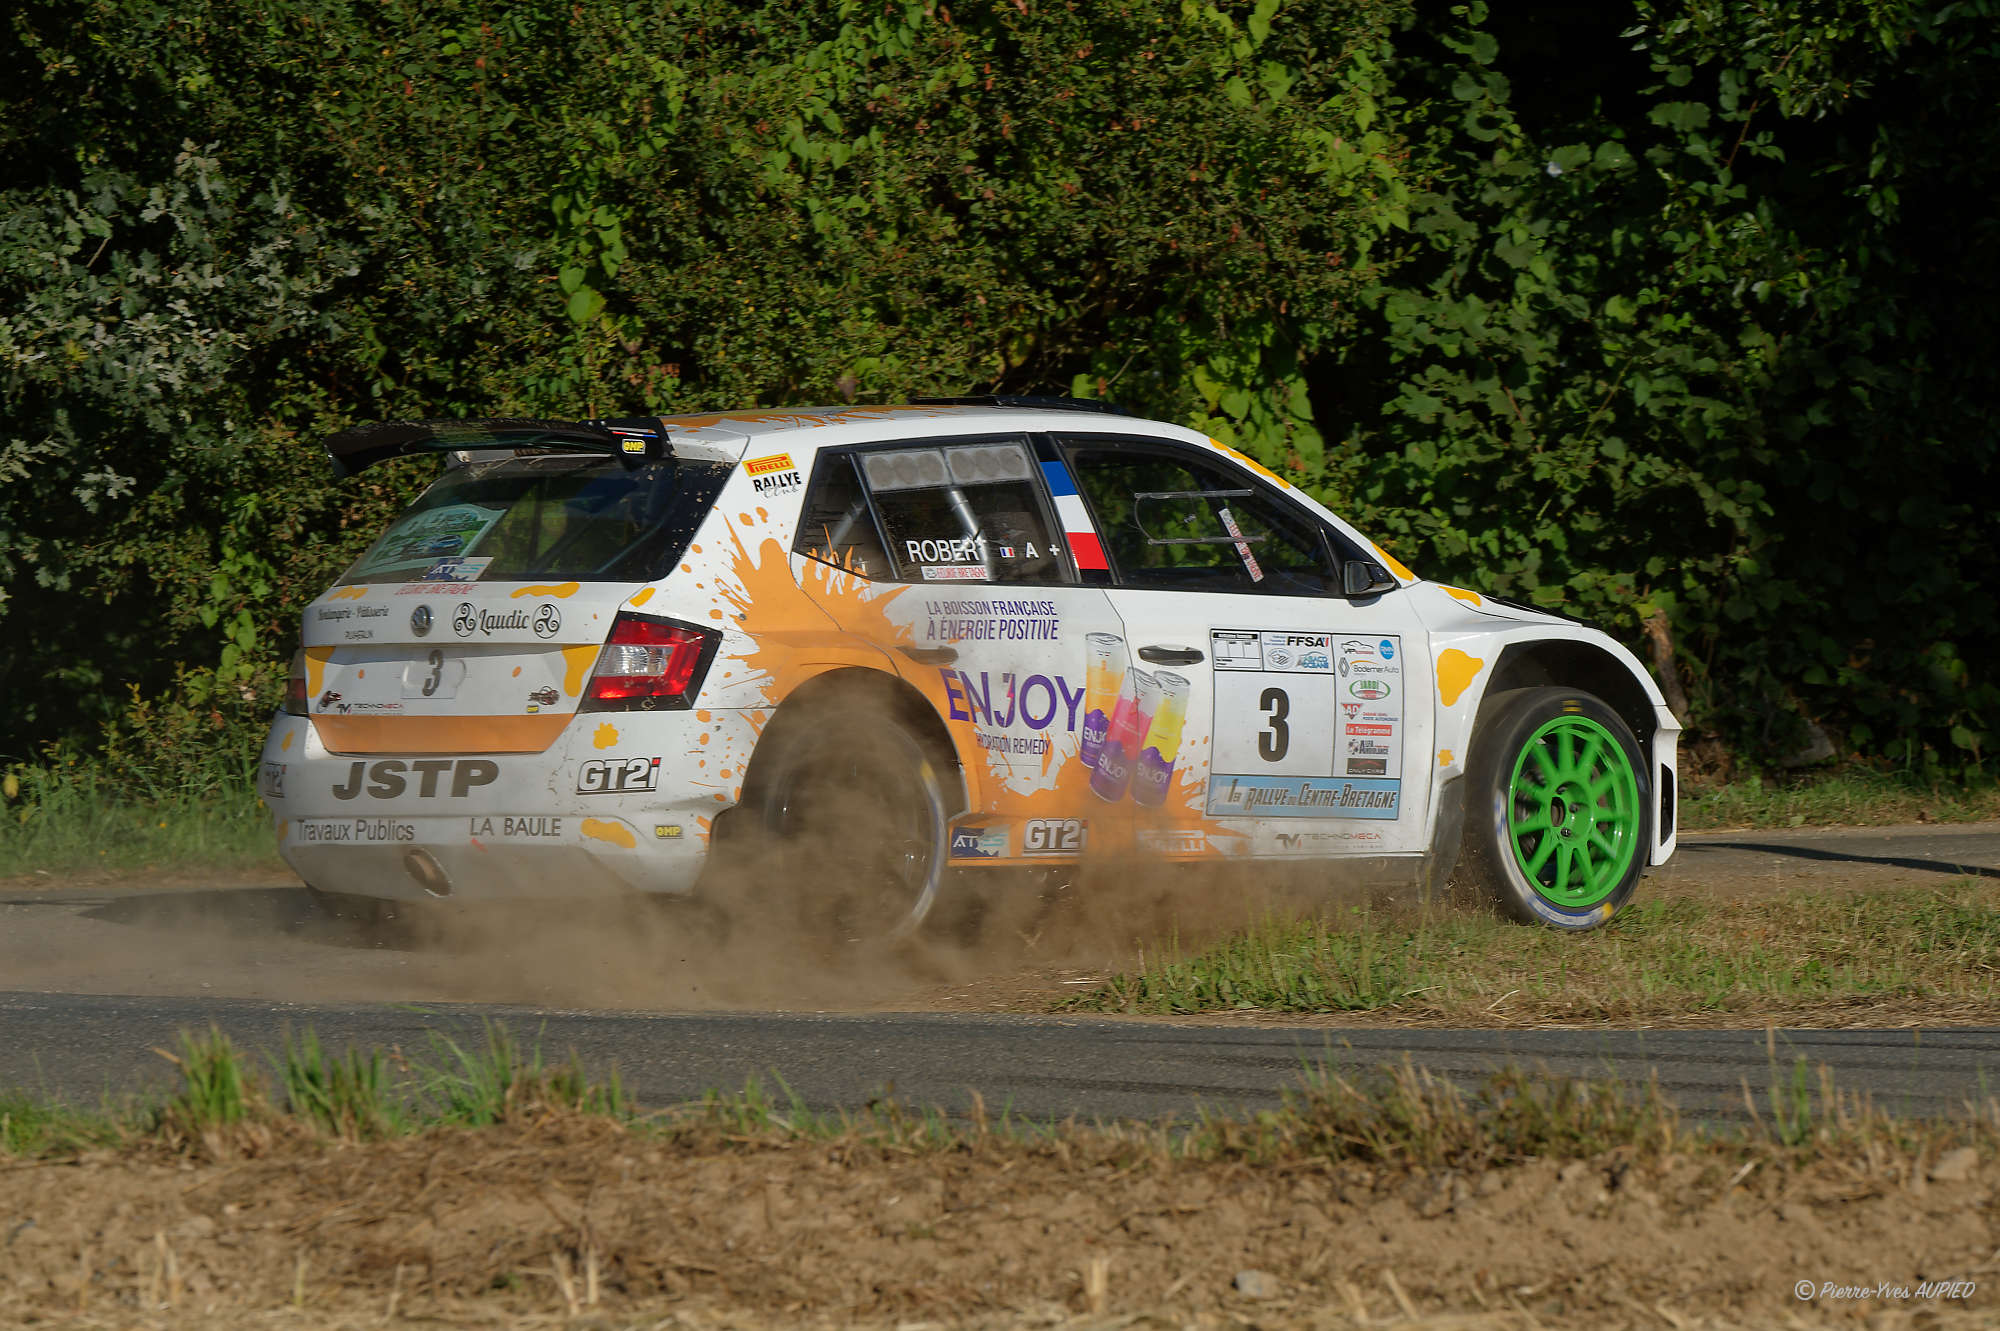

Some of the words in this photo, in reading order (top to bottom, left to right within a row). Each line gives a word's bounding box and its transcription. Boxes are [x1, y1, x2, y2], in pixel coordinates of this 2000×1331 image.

[748, 455, 791, 474] PIRELLI
[752, 472, 802, 492] RALLYE
[1026, 542, 1039, 559] A
[926, 601, 943, 615] LA
[944, 601, 991, 616] BOISSON
[992, 601, 1058, 618] FRANÇAISE
[478, 608, 530, 636] Laudic
[926, 616, 936, 640] À
[940, 616, 997, 640] ÉNERGIE
[998, 619, 1060, 640] POSITIVE
[1287, 636, 1325, 648] FFSA
[422, 650, 444, 697] 3
[939, 668, 1085, 732] ENJOY
[1083, 726, 1106, 744] ENJ
[1258, 687, 1290, 762] 3
[1013, 737, 1050, 755] REMEDY
[331, 759, 500, 801] JSTP
[577, 757, 662, 793] GT2i
[1243, 787, 1289, 811] RALLYE
[1299, 783, 1398, 809] CENTRE-BRETAGNE
[298, 819, 351, 842] Travaux
[355, 818, 415, 842] Publics
[470, 818, 494, 837] LA
[504, 818, 562, 838] BAULE
[655, 825, 682, 838] OMP
[1024, 818, 1089, 850] GT2i
[1304, 832, 1382, 840] TECHNOMECA
